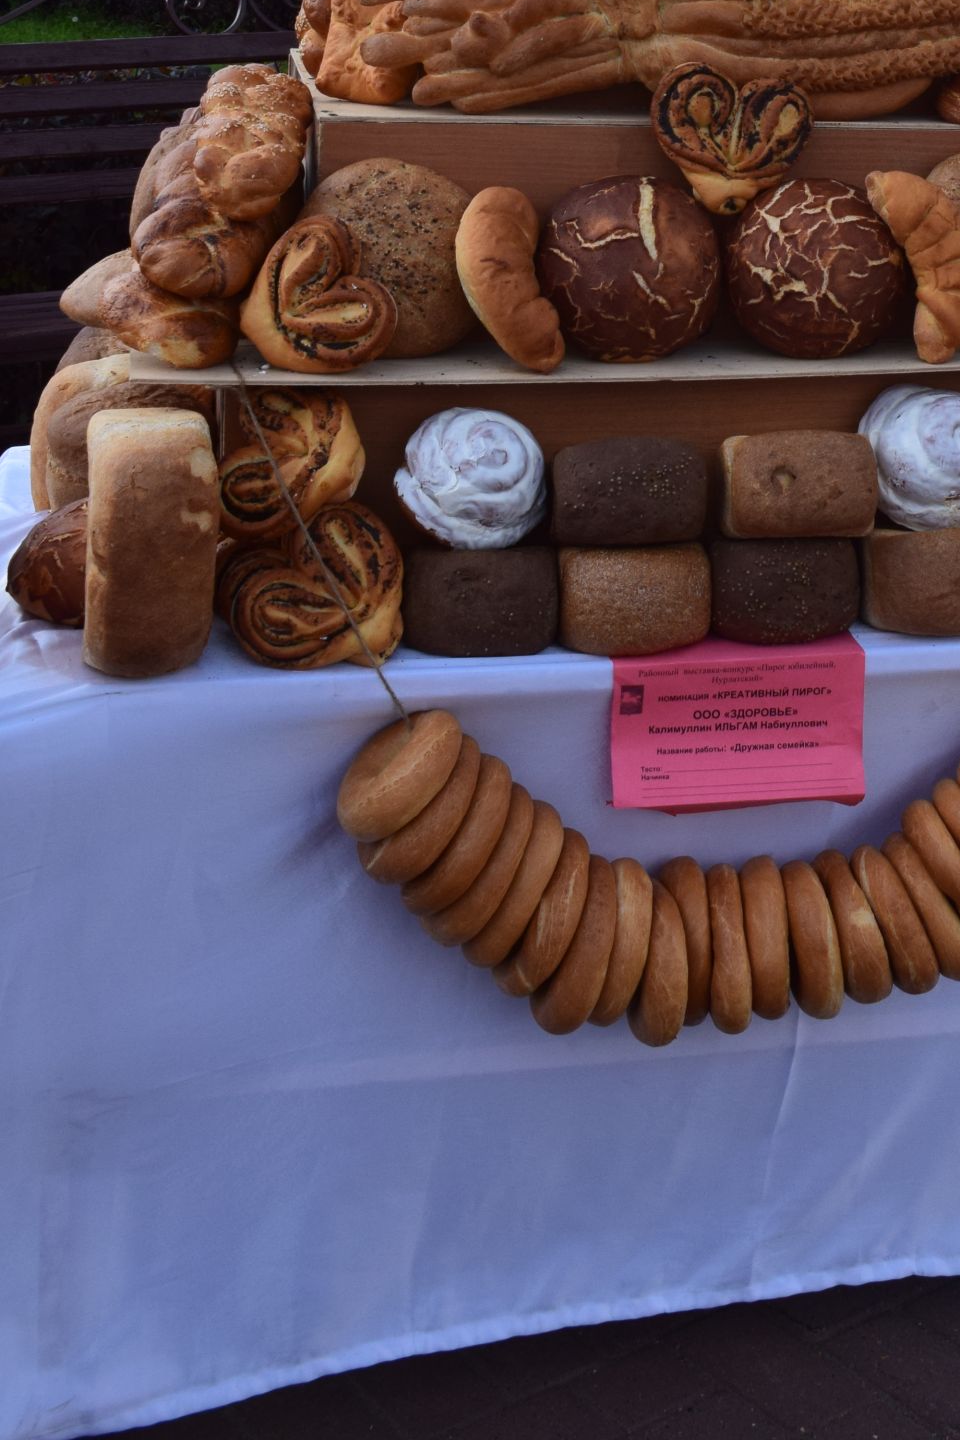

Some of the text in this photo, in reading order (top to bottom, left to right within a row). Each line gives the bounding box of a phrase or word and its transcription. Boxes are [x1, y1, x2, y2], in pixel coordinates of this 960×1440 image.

[638, 667, 679, 678] Районный
[712, 688, 789, 700] «КРЕАТИВНЫЙ
[792, 686, 832, 697] ПИРОГ»
[692, 706, 798, 720] ООО «ЗДОРОВЬЕ»
[648, 719, 828, 735] Калимуллин ИЛЬГАМ Набиуллович
[656, 739, 819, 756] Название работы: «Дружная семейка»
